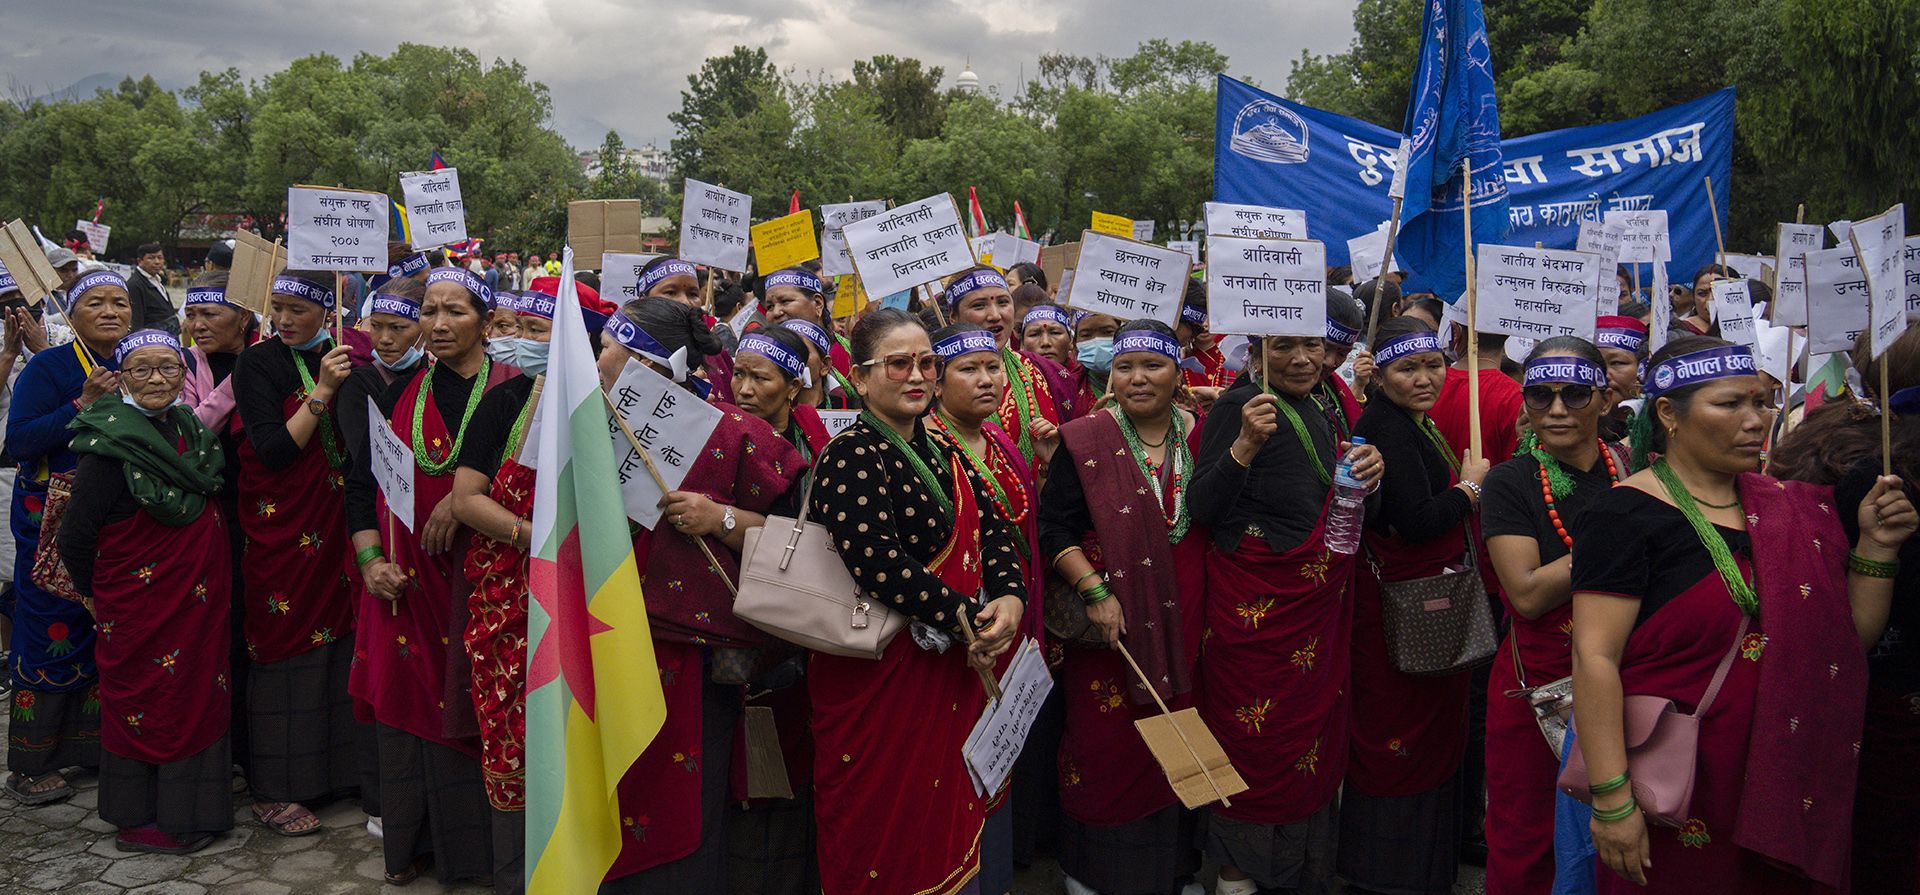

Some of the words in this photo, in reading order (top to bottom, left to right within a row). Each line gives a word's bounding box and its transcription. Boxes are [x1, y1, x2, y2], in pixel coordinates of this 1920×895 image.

[1567, 122, 1705, 177] समाज
[320, 196, 347, 211] संयुक्त
[352, 200, 371, 212] राष्ट्र
[414, 201, 443, 216] जनजाति
[314, 213, 341, 226] संघीय
[347, 215, 375, 228] घोषणा
[878, 204, 933, 233] आदिवासी
[1235, 209, 1262, 222] संयुक्त
[1267, 214, 1286, 226] राष्ट्र
[331, 235, 359, 247] २००७
[866, 235, 918, 263] जनजाति
[923, 222, 958, 246] एकता
[312, 251, 358, 265] कार्यन्वयन
[362, 257, 375, 265] गर
[892, 250, 949, 279] जिन्दावाद
[1116, 249, 1161, 270] छन्त्याल
[1243, 245, 1302, 265] आदिवासी
[1501, 252, 1536, 268] जातीय
[1542, 255, 1584, 272] भेदभाव
[1100, 268, 1139, 288] स्वायत्त
[1145, 276, 1167, 294] क्षेत्र
[1223, 273, 1277, 291] जनजाति
[1284, 278, 1322, 295] एकता
[1495, 275, 1536, 291] उन्मुलन
[1542, 276, 1587, 295] विरुद्धको
[536, 298, 555, 314] संघ
[1097, 288, 1135, 310] घोषणा
[1141, 301, 1159, 315] गर
[1243, 300, 1303, 320] जिन्दावाद
[1514, 298, 1562, 314] महासन्धि
[1499, 316, 1552, 335] कार्यन्वयन
[1123, 336, 1163, 351] छन्त्याल
[1394, 336, 1435, 354] छन्त्याल
[747, 338, 787, 362] छन्त्याल
[787, 354, 799, 371] संघ
[1527, 365, 1576, 382] छन्त्याल
[1578, 364, 1594, 382] संघ
[1676, 359, 1721, 380] नेपाल
[652, 391, 676, 418] एक
[661, 445, 684, 467] हौं
